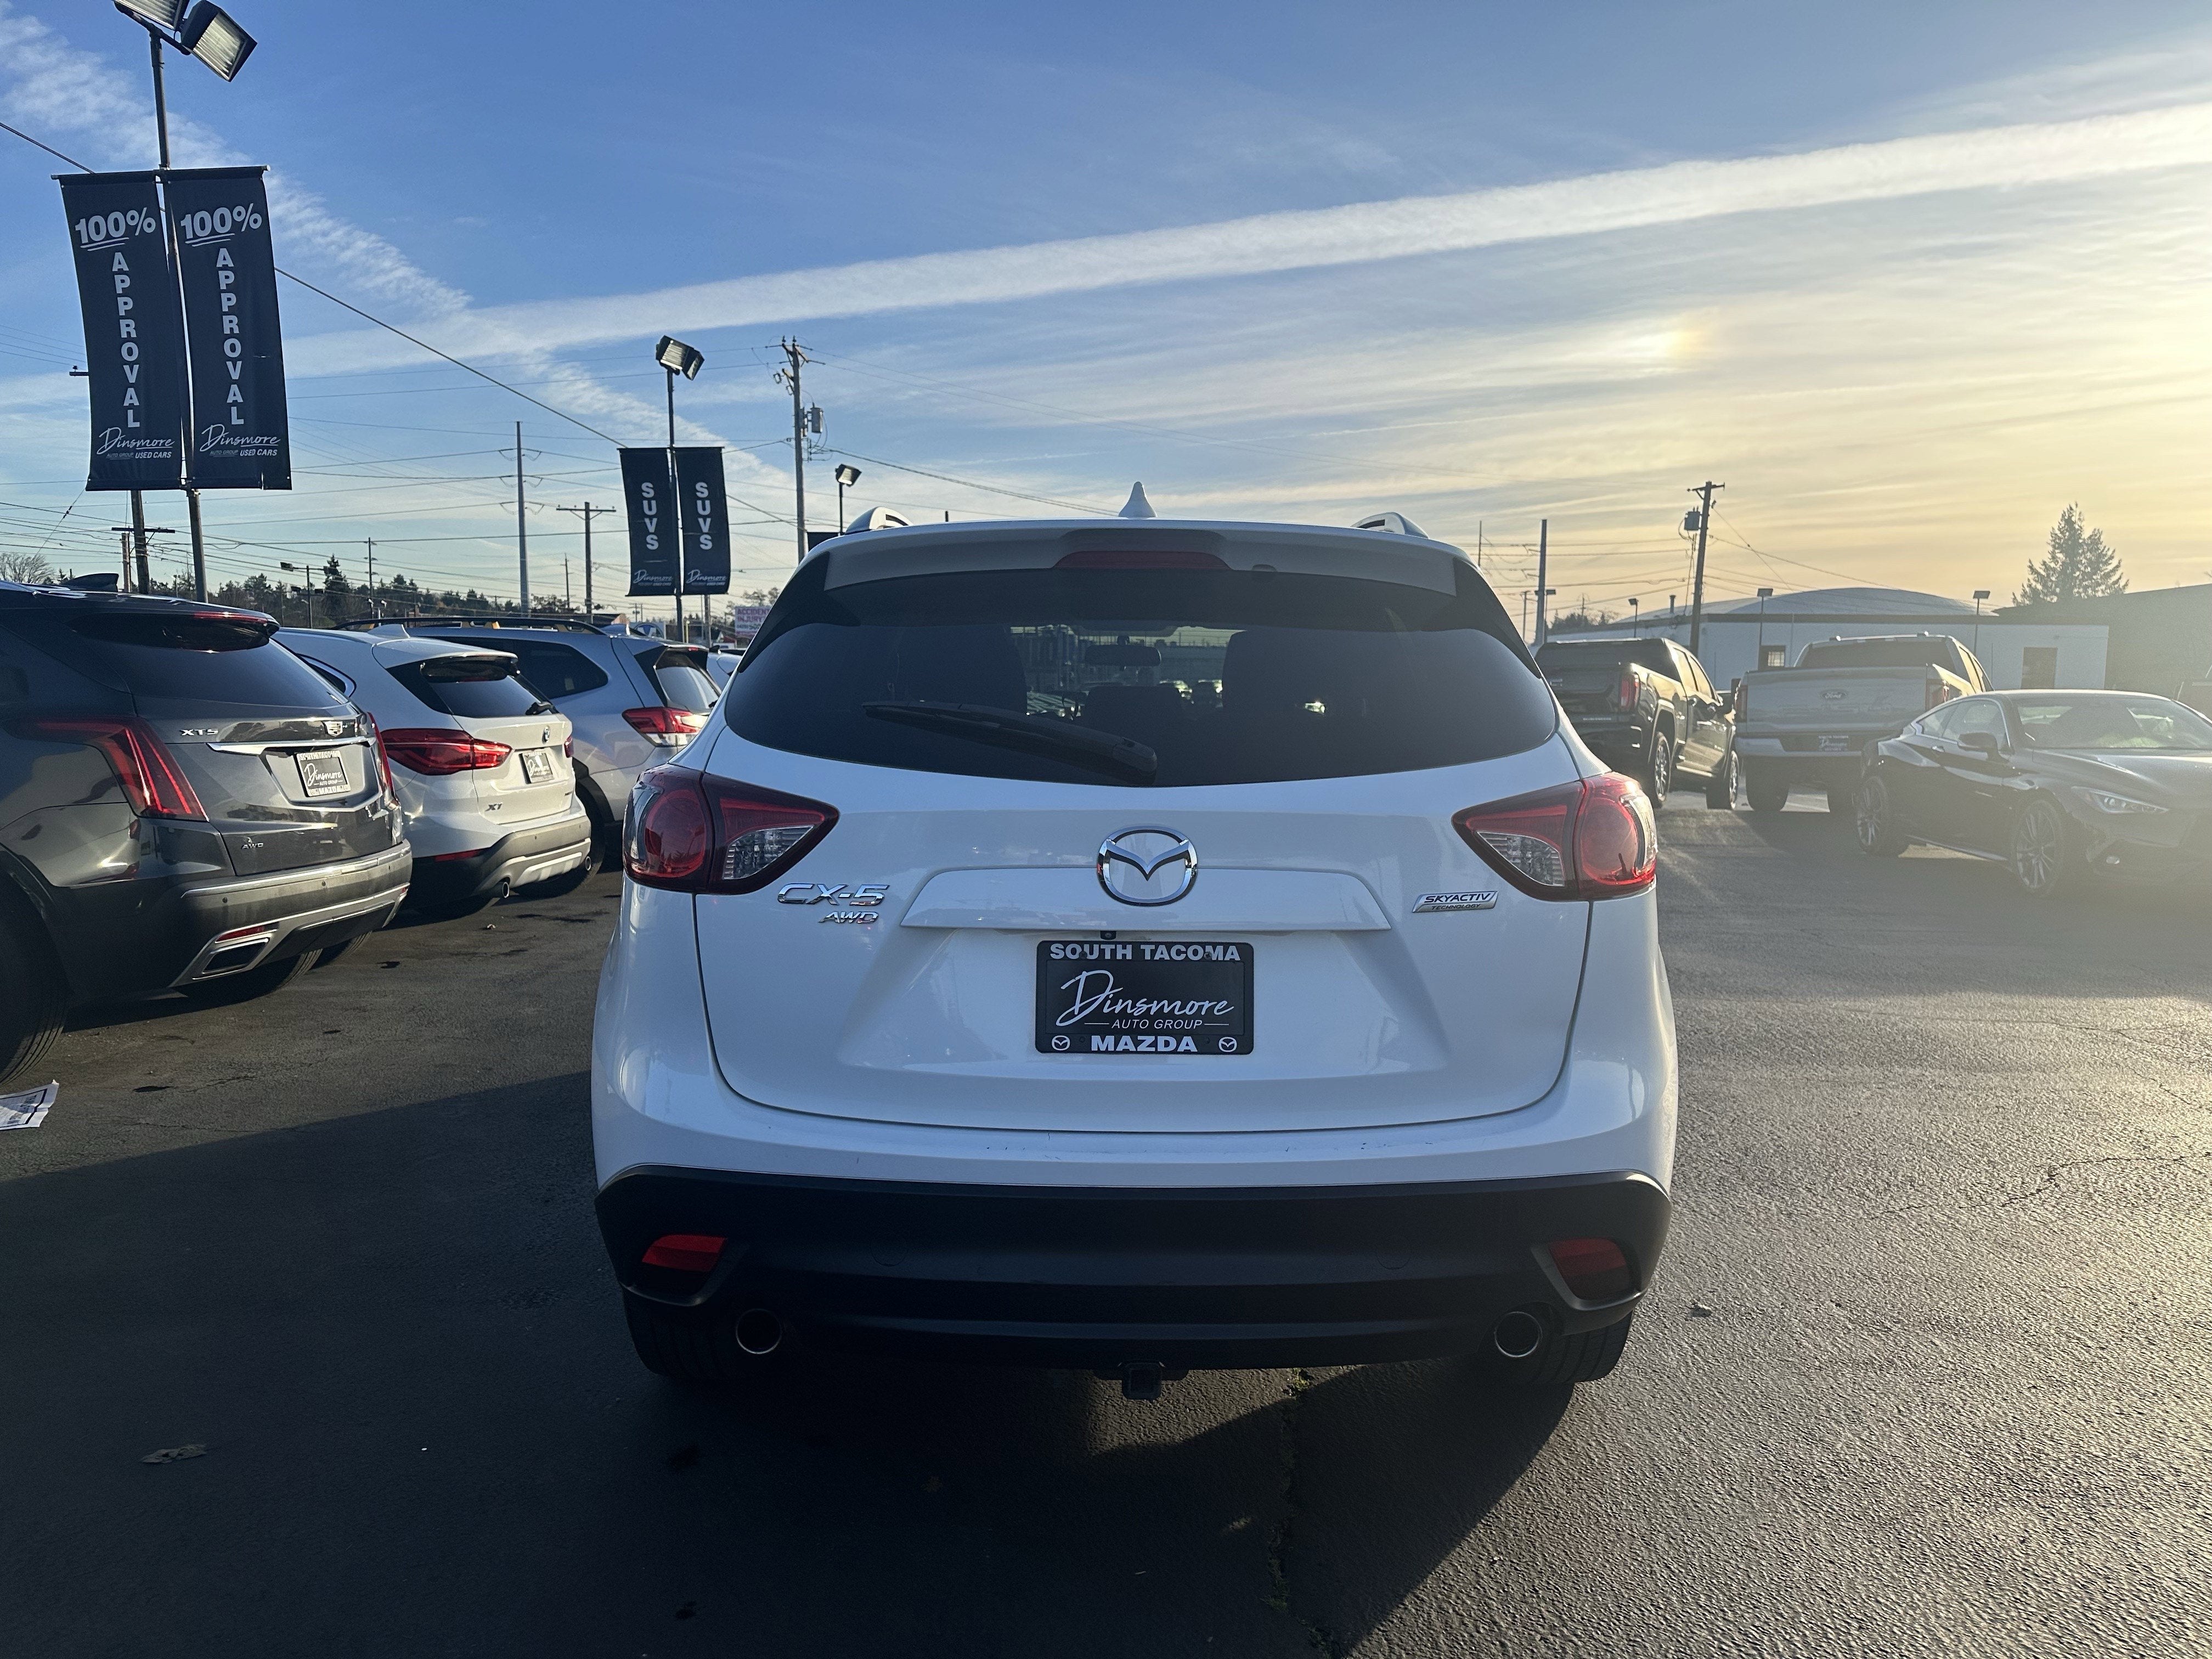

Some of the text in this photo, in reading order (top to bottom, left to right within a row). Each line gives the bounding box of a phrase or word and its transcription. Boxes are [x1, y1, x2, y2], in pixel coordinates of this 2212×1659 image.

[75, 207, 156, 244] 100%
[180, 203, 262, 240] 100%
[111, 252, 140, 428] APPROVAL
[216, 248, 244, 425] APPROVAL
[97, 427, 175, 454] Dinsmore
[200, 424, 281, 452] Dinsmore
[641, 482, 659, 550] SUVS
[695, 482, 713, 550] SUVS
[485, 802, 503, 812] X1
[777, 883, 890, 906] CX-5
[1424, 893, 1491, 903] SKYACTIV
[818, 911, 879, 924] AWD
[1050, 943, 1241, 961] SOUTH TACOMA
[1056, 969, 1234, 1026] Dinsmore
[1111, 1019, 1203, 1030] AUTO GROUP
[1091, 1035, 1198, 1052] MAZDA
